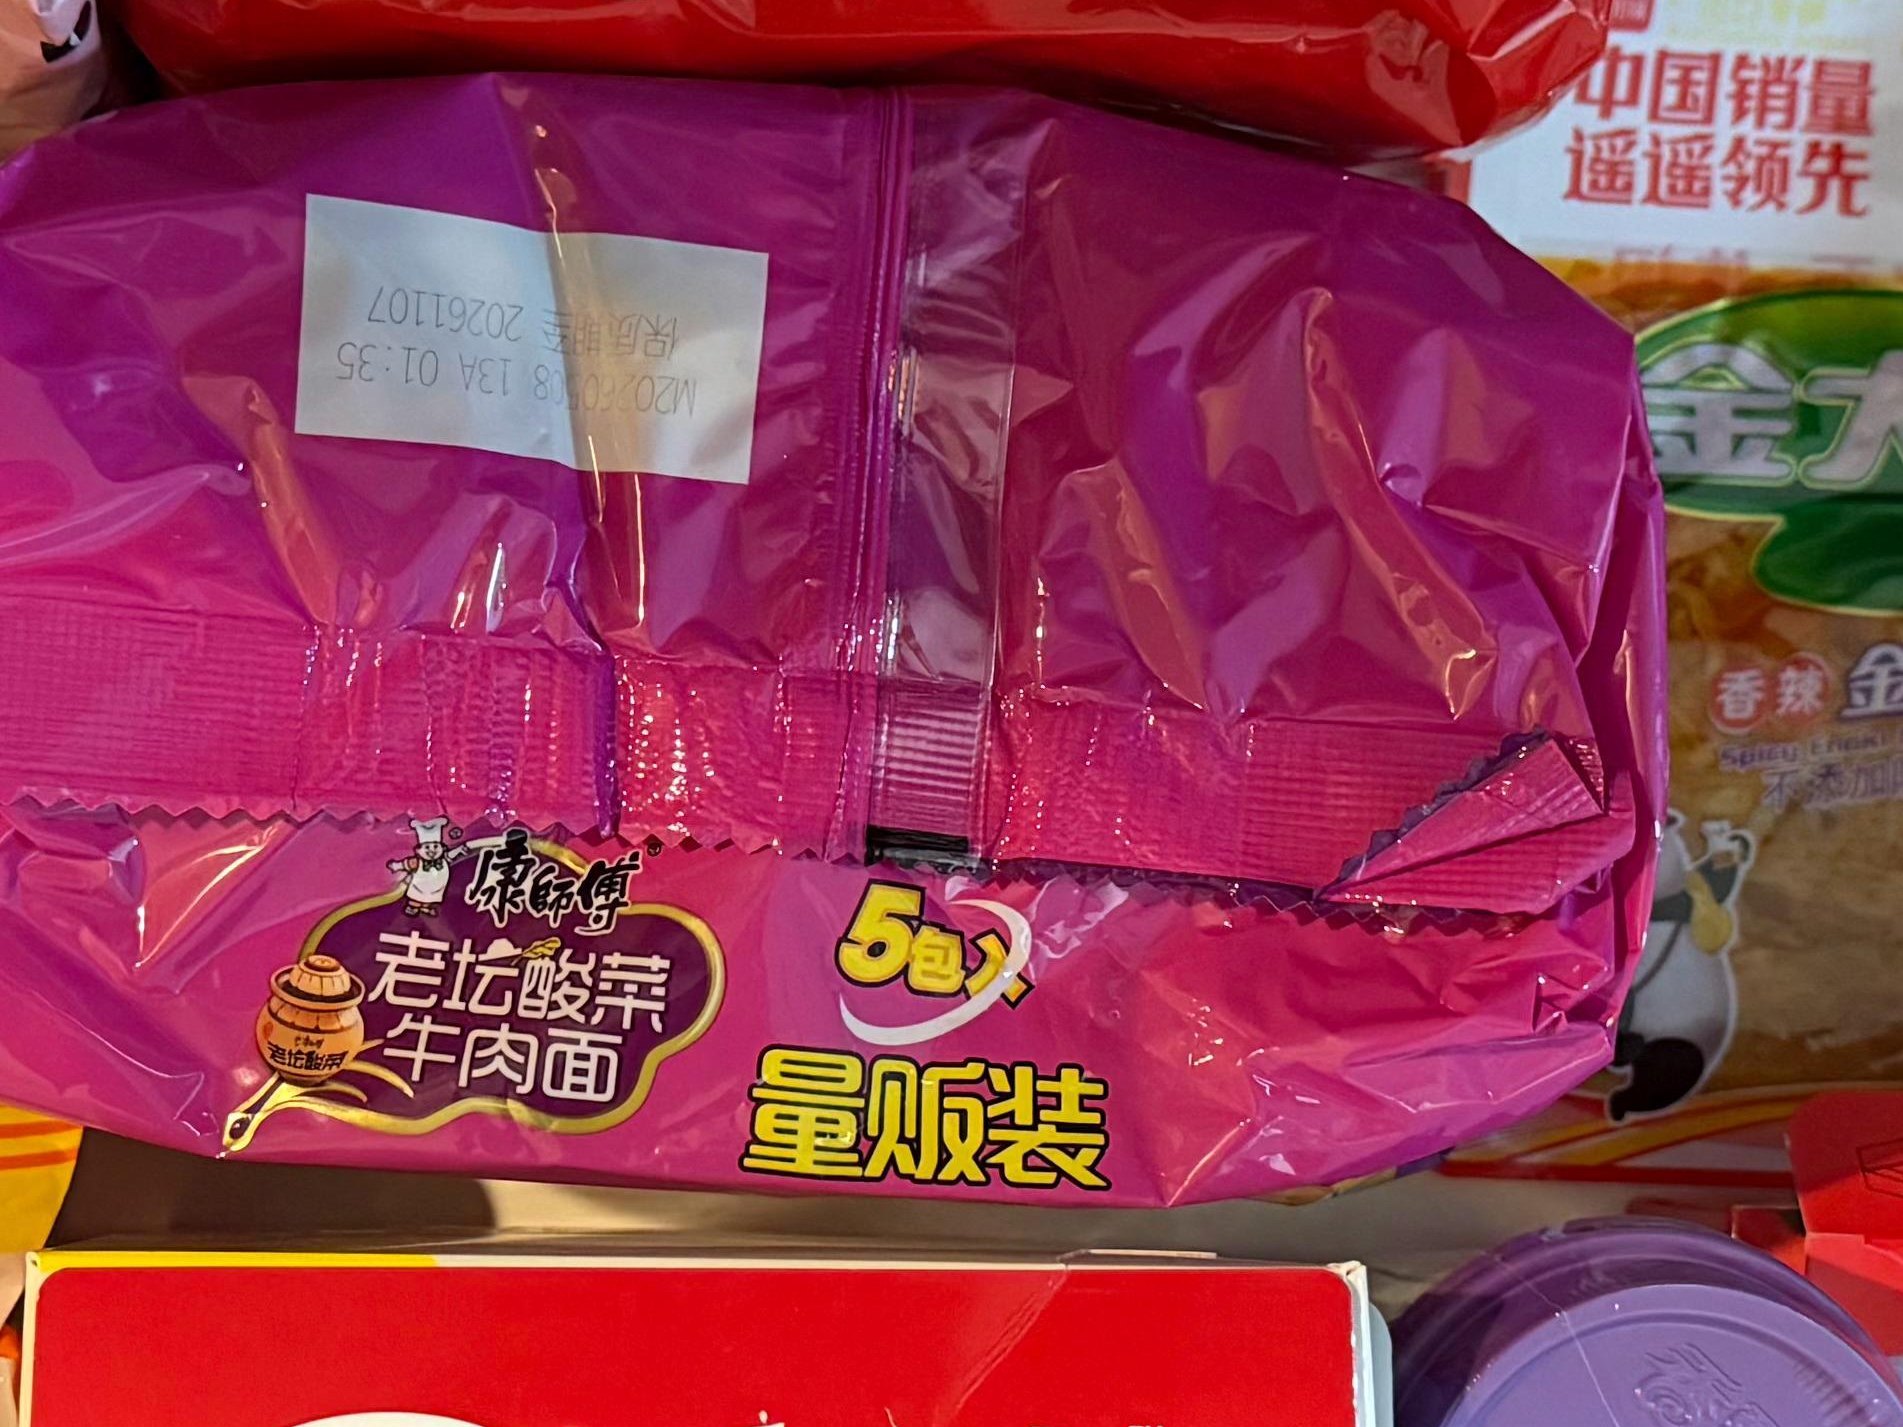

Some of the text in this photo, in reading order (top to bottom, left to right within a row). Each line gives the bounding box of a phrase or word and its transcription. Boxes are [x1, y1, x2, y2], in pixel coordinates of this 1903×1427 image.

[1574, 46, 1875, 136] 中国销量
[1563, 126, 1870, 218] 遥遥领先
[367, 285, 524, 342] 20261107
[337, 342, 440, 387] 01:35
[459, 353, 512, 397] 13A
[1716, 664, 1826, 721] 香辣
[465, 828, 643, 936] 康師傅
[368, 929, 671, 1035] 老坛酸菜
[383, 1012, 622, 1105] 牛肉面
[740, 1045, 1112, 1191] 量贩装
